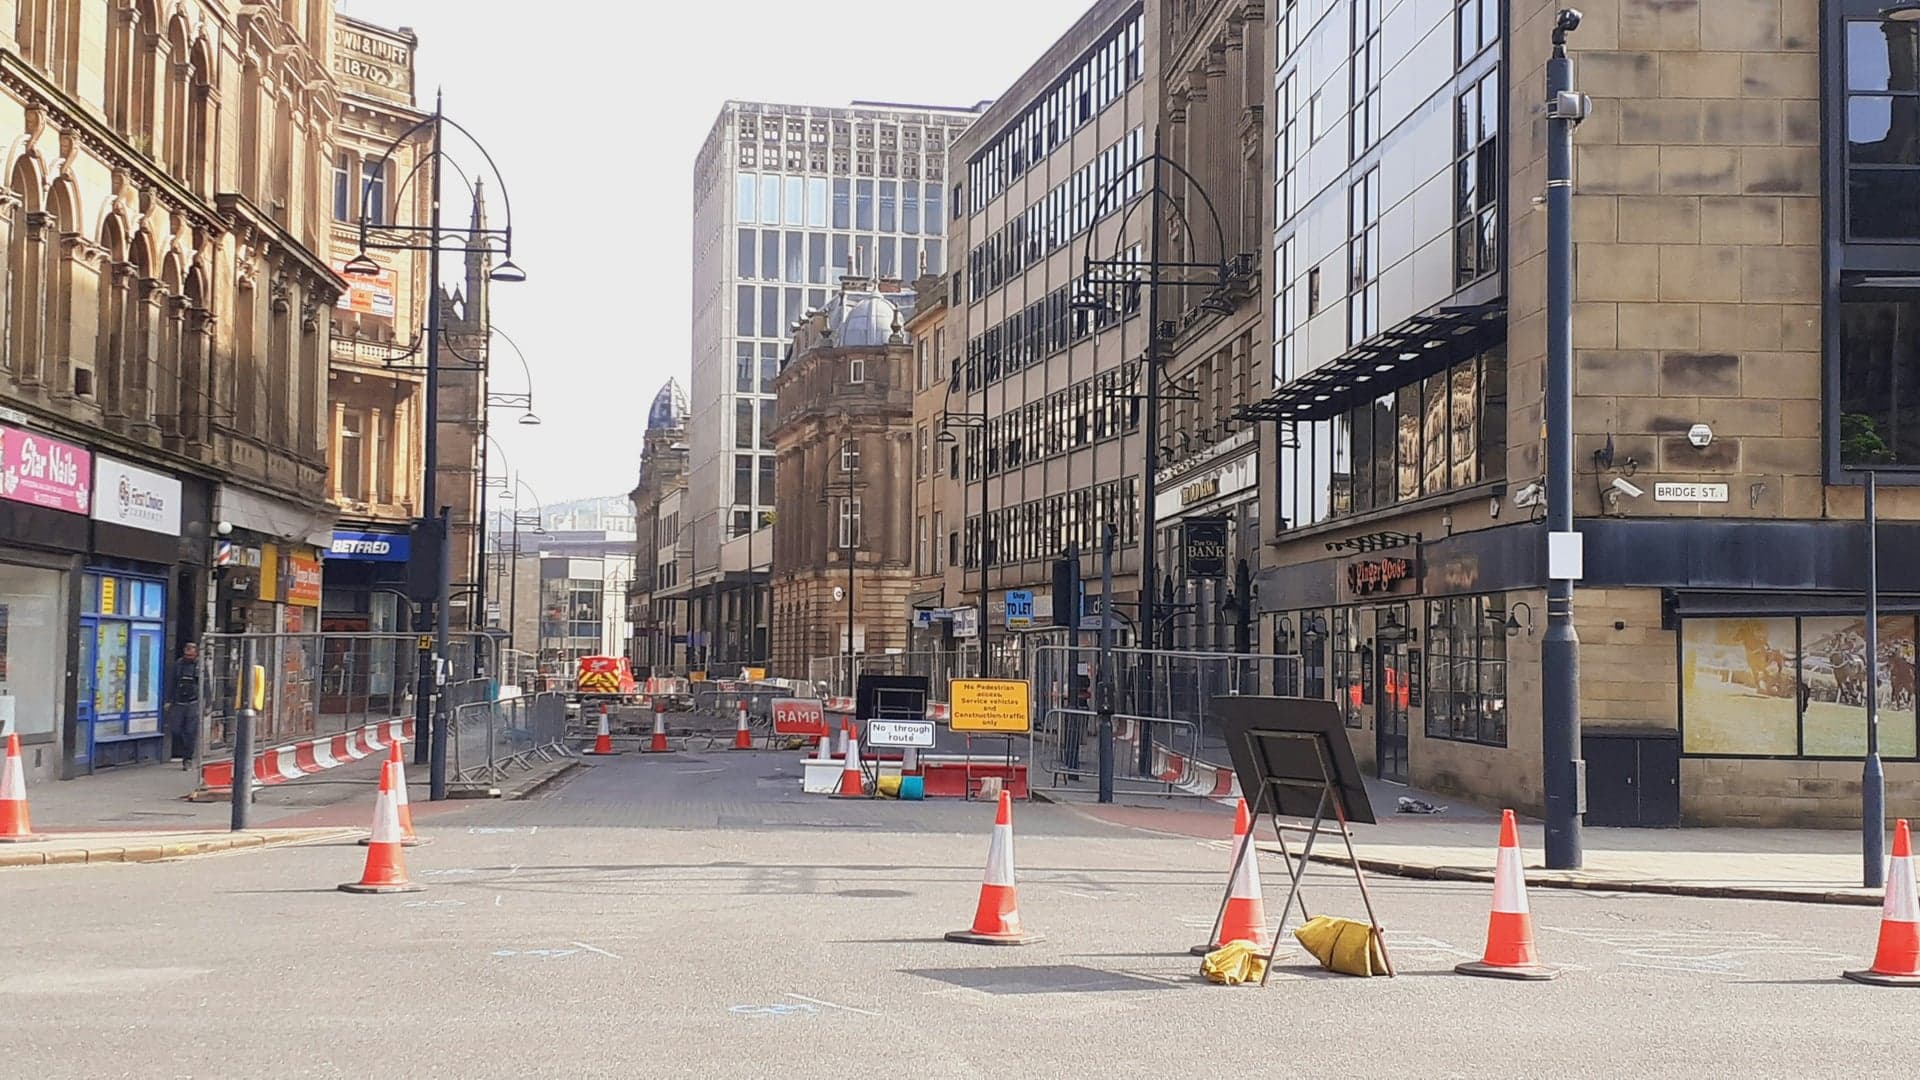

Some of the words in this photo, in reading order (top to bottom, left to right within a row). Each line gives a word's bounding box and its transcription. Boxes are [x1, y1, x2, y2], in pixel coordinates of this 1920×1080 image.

[20, 438, 47, 478] Star
[49, 445, 77, 486] Nails
[1658, 487, 1696, 497] BRIDGE
[331, 540, 391, 555] BETFRED
[1188, 545, 1225, 557] BANK
[1007, 603, 1018, 615] TO
[1019, 602, 1031, 615] LET
[777, 711, 820, 723] RAMP
[872, 724, 886, 732] No
[893, 723, 930, 734] through
[888, 733, 914, 742] route
